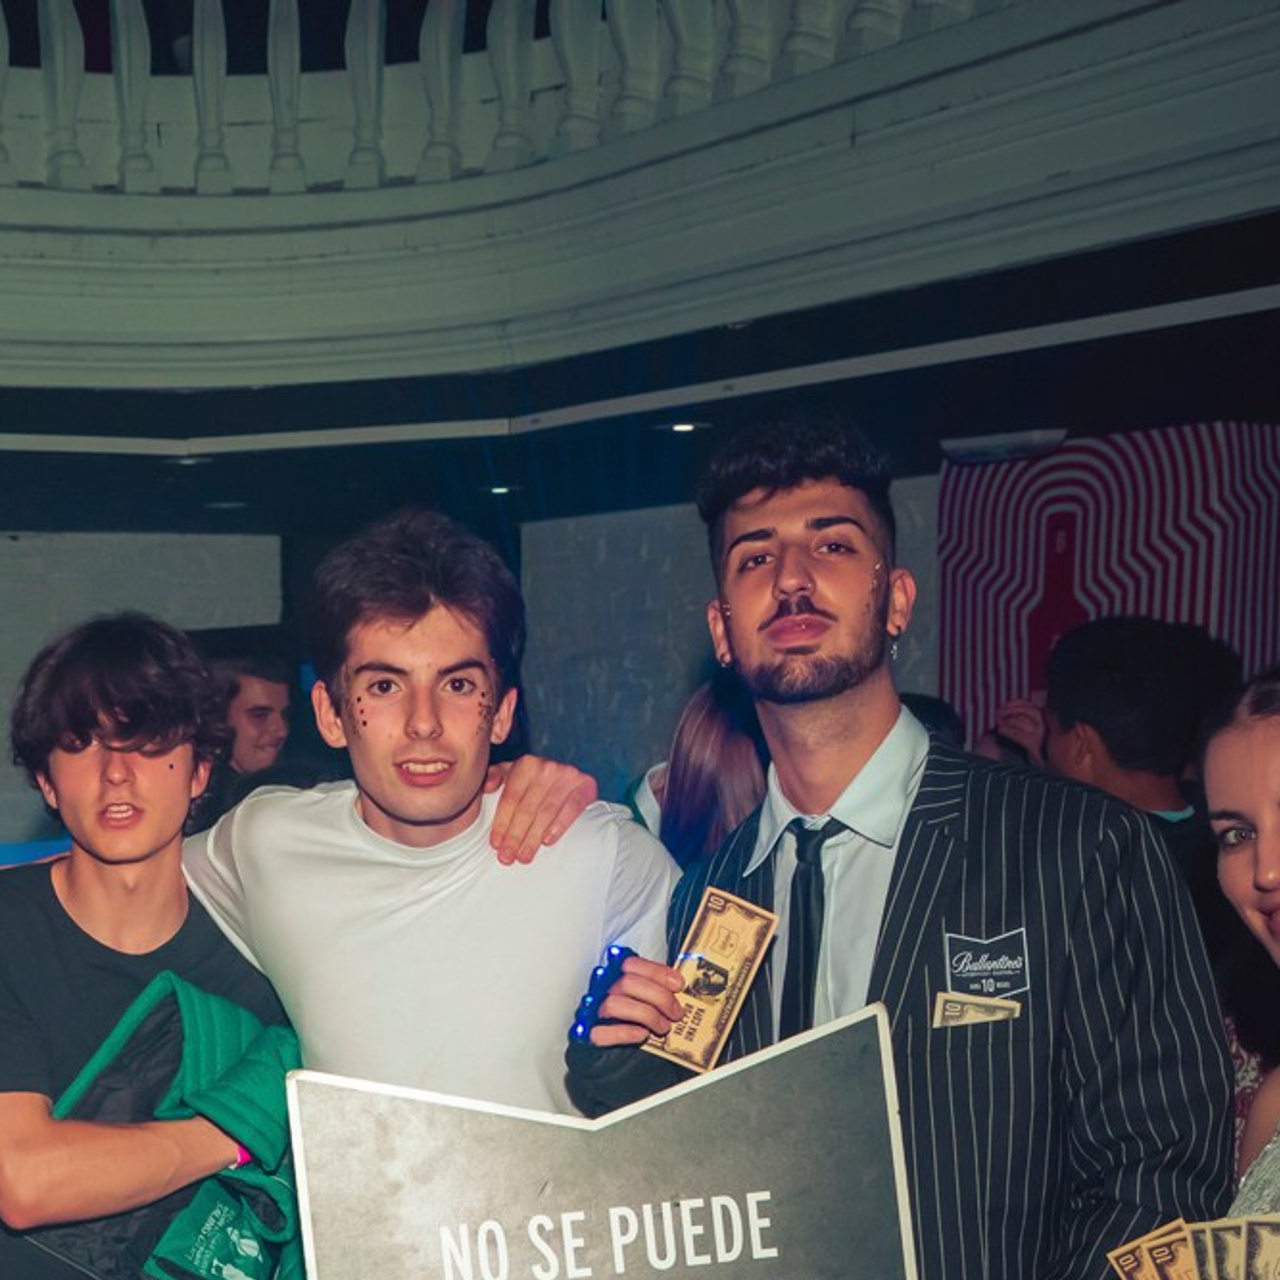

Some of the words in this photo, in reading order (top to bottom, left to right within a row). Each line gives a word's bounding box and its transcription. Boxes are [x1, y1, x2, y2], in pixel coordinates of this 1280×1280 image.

[708, 895, 725, 910] 10
[981, 978, 995, 992] 10
[944, 1003, 961, 1016] 10
[608, 1190, 779, 1274] PUEDE
[1120, 1254, 1138, 1271] 10
[1153, 1246, 1171, 1263] 10
